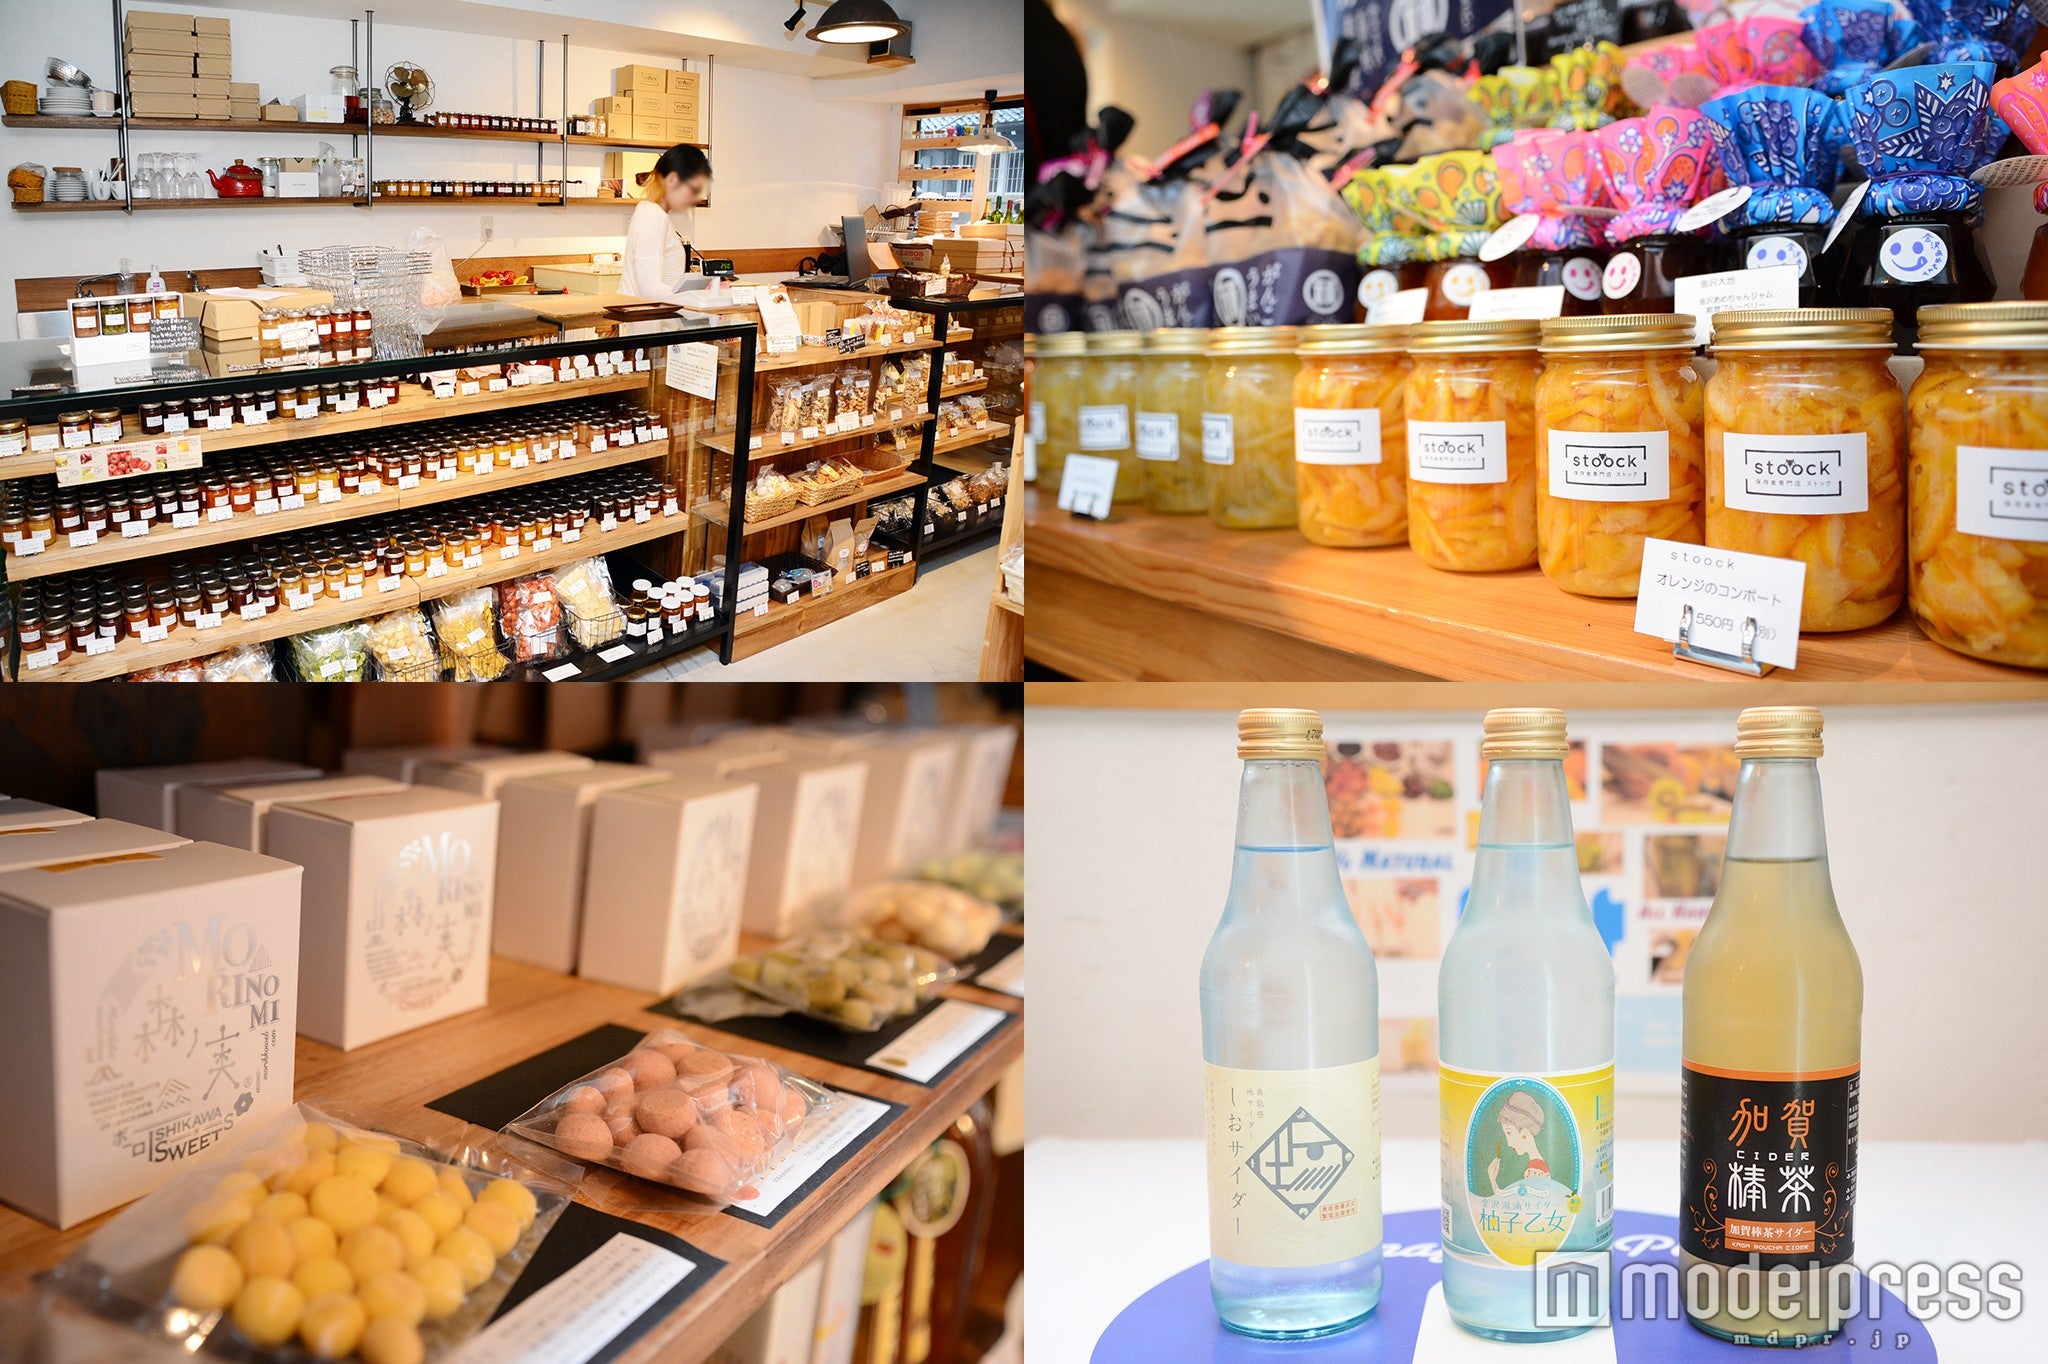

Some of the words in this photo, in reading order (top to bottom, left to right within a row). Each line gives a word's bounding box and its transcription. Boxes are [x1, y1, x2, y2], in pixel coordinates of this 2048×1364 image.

[1424, 440, 1476, 454] stoock
[1573, 453, 1637, 468] stoock
[1755, 459, 1830, 476] stoock
[1755, 478, 1802, 487] 保存食専門店
[1806, 479, 1832, 487] ストック
[1670, 550, 1736, 571] stoock
[1656, 572, 1782, 608] オレンジのコンポート
[1696, 612, 1733, 632] 550円
[172, 912, 258, 983] MO
[249, 999, 281, 1032] MI
[1728, 1097, 1816, 1149] 加賀
[1228, 1086, 1248, 1235] しおサイダー
[1736, 1150, 1810, 1162] CIDER
[1727, 1161, 1816, 1214] 棒茶
[1479, 1207, 1567, 1234] 柚子乙女
[1729, 1222, 1812, 1240] 加賀棒茶サイダー
[1754, 1243, 1783, 1251] BOUCHA
[1786, 1243, 1809, 1251] CIDER
